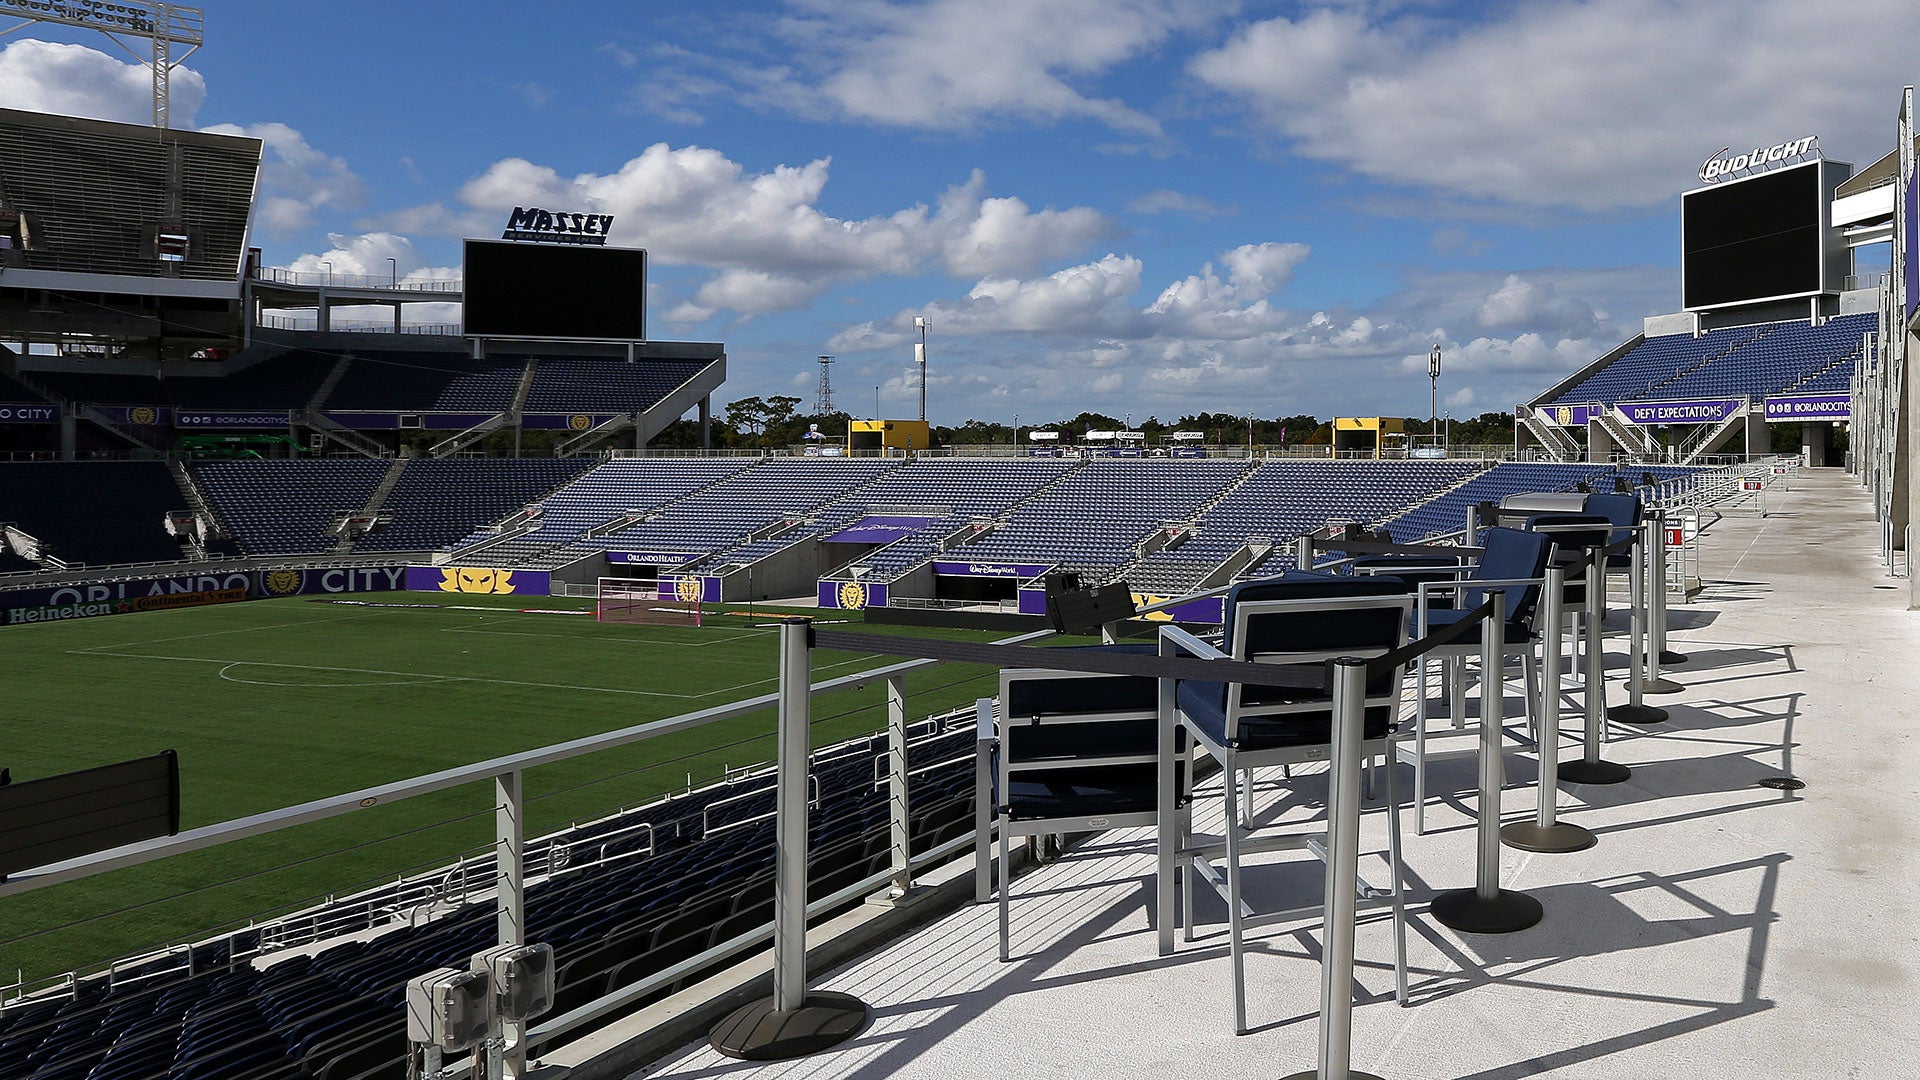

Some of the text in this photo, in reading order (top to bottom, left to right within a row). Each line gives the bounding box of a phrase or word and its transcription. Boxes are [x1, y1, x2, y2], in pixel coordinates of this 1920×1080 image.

[1705, 135, 1817, 179] BUD LIGHT
[506, 207, 613, 234] MASSEY
[16, 408, 53, 419] CITY
[1634, 403, 1722, 419] DEFY EXPECTATIONS
[627, 553, 684, 563] ORLANDO HEALTH
[321, 568, 404, 593] CITY
[138, 591, 242, 609] Continental TIRE
[9, 603, 111, 624] Heineken
